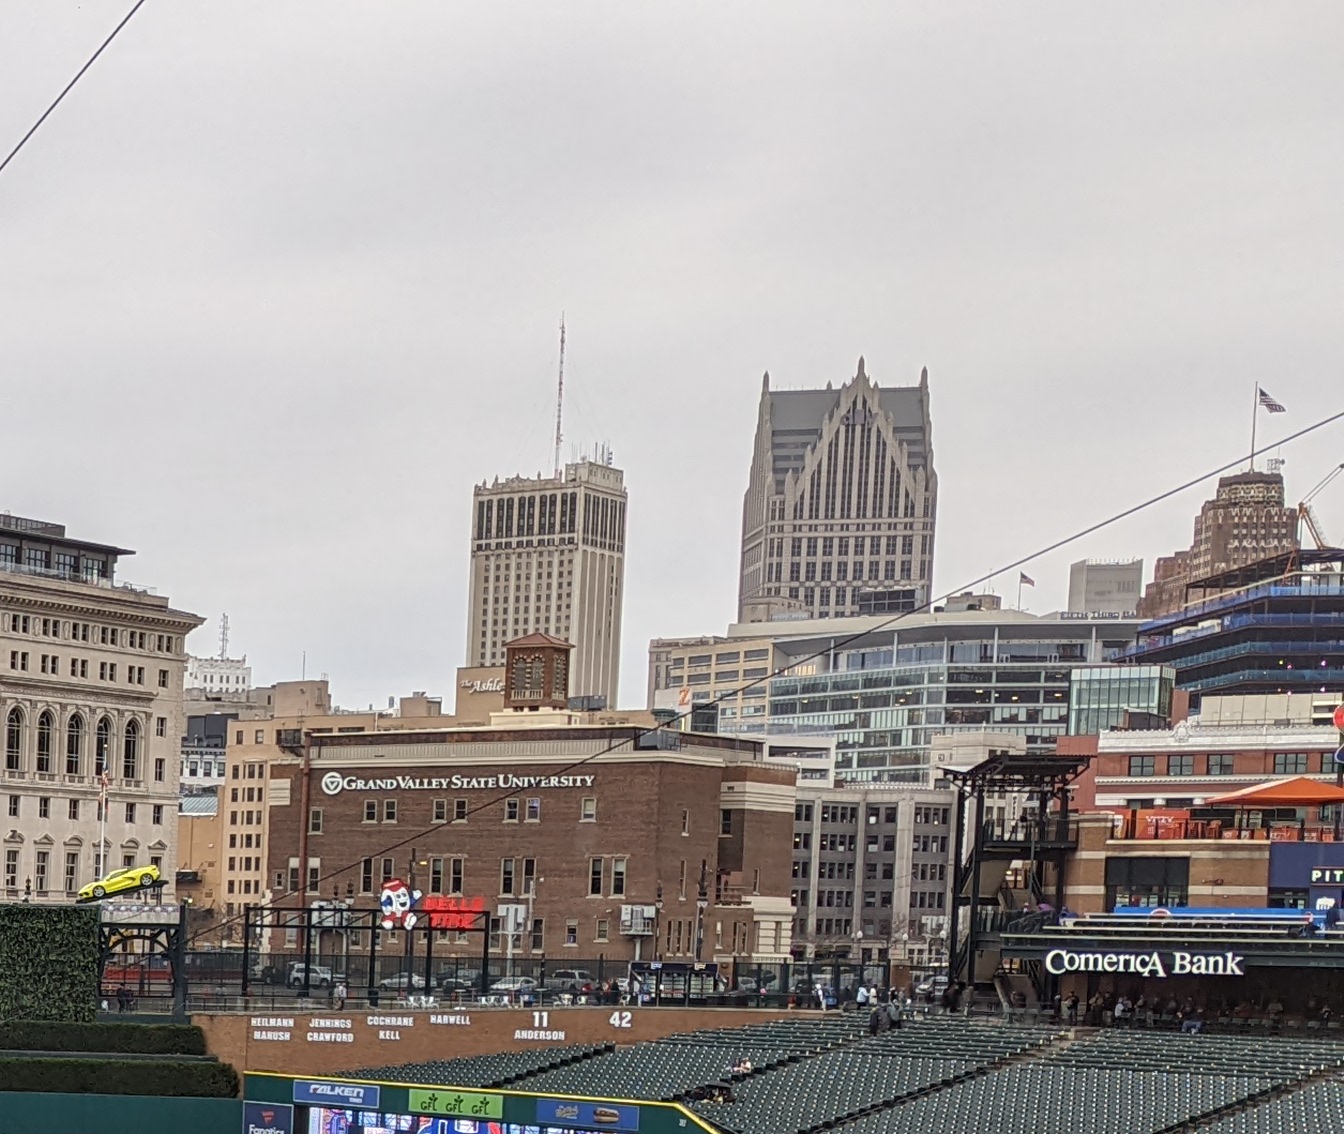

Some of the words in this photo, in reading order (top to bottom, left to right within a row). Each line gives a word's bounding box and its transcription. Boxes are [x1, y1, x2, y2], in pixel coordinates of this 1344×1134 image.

[469, 677, 505, 694] Ashle
[343, 777, 396, 790] GRAND
[396, 775, 450, 789] VALLEY
[451, 775, 497, 789] STATE
[498, 774, 594, 788] UNIVERSITY
[1172, 952, 1245, 976] Bank
[367, 1015, 414, 1026] COCHRANE
[533, 1012, 548, 1028] 11
[609, 1011, 632, 1028] 42
[379, 1030, 400, 1040] KELL
[514, 1029, 566, 1041] ANDERSON
[309, 1084, 364, 1098] FALKEN
